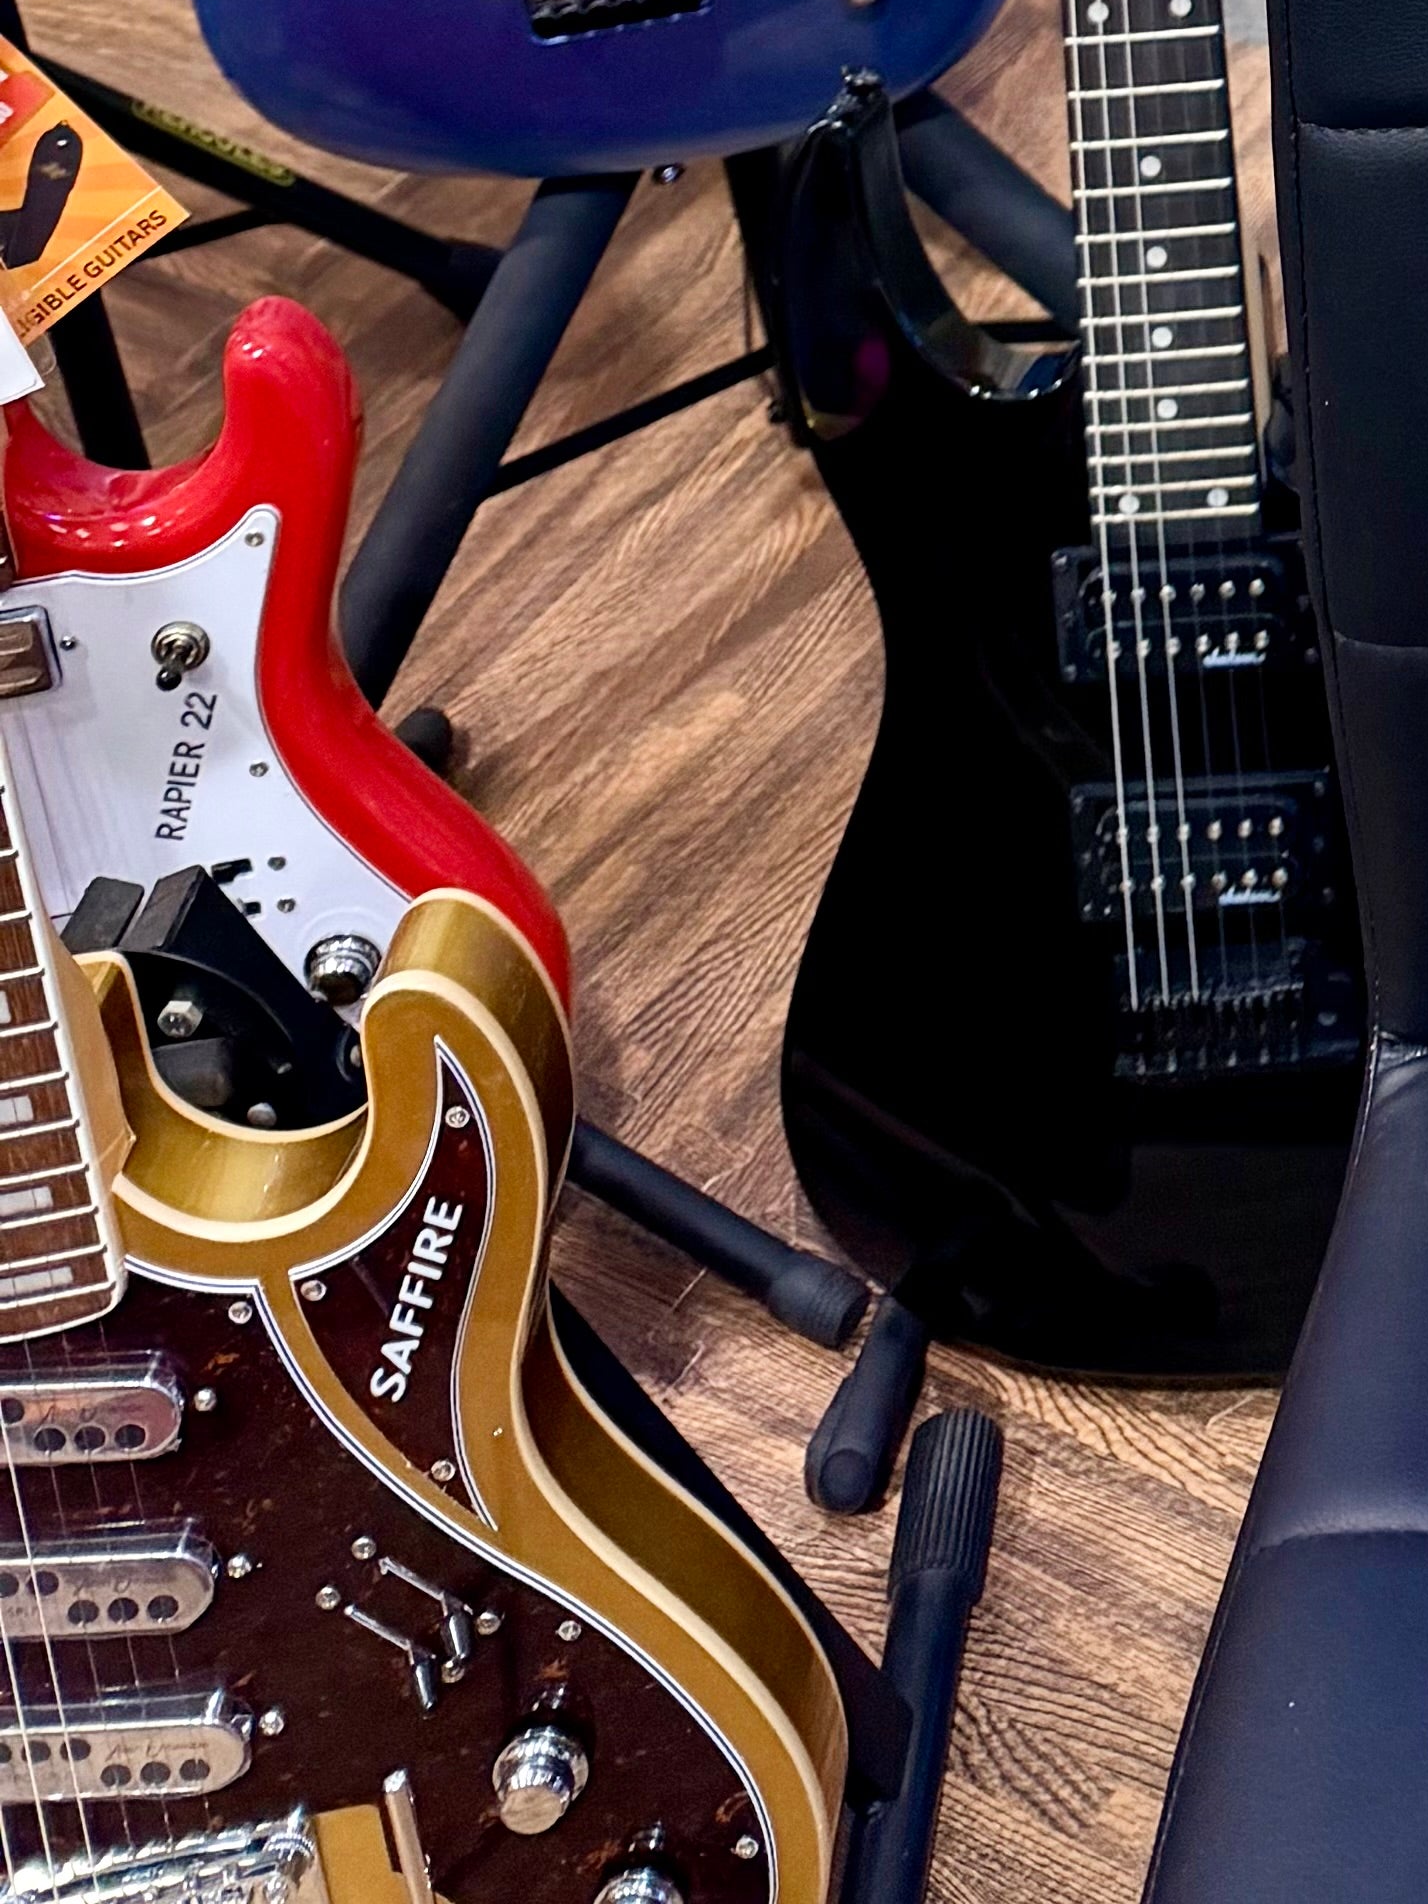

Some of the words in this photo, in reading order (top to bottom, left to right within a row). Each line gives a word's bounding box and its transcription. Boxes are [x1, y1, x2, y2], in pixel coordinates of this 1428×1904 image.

[17, 273, 88, 338] IGIBLE
[83, 209, 168, 279] GUITARS
[180, 692, 218, 730] 22
[155, 741, 206, 841] RAPIER
[370, 1196, 464, 1403] SAFFIRE
